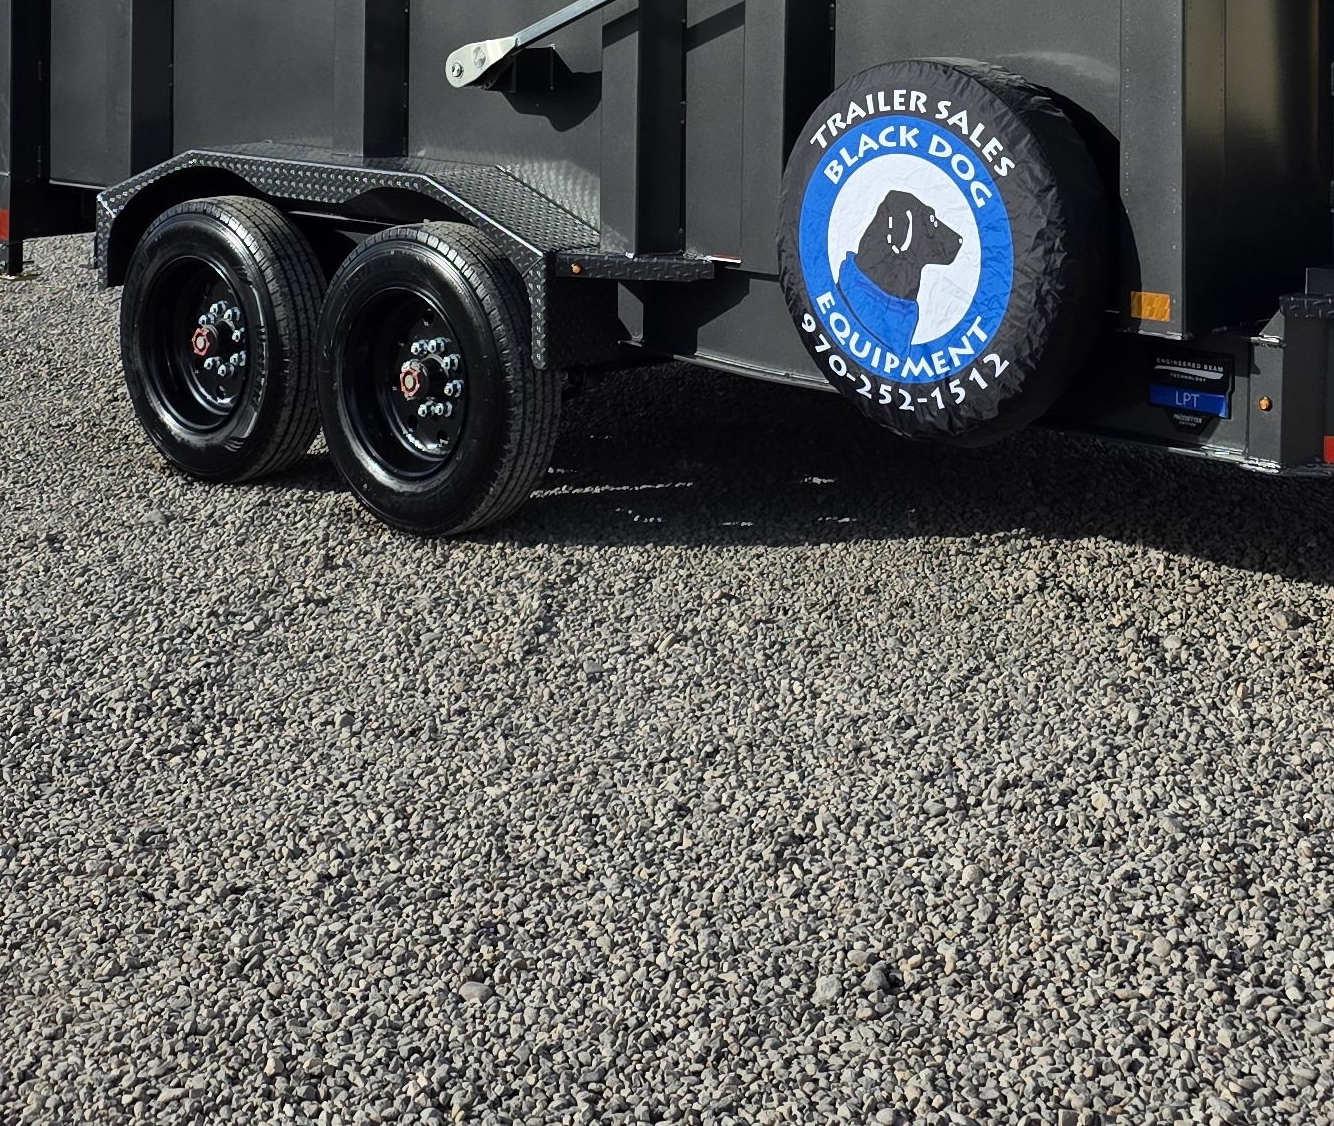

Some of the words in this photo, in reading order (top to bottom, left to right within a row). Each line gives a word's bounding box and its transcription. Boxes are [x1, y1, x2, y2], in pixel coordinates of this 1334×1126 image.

[810, 89, 928, 150] TRAILER
[934, 100, 1015, 177] SALES
[823, 125, 919, 185] BLACK
[928, 133, 993, 208] DOG
[802, 313, 1010, 412] 970-252-1512
[816, 291, 989, 379] EQUIPMENT
[1157, 358, 1201, 369] ENGINEERED
[1204, 364, 1224, 372] BEAM
[1175, 391, 1200, 408] LPT
